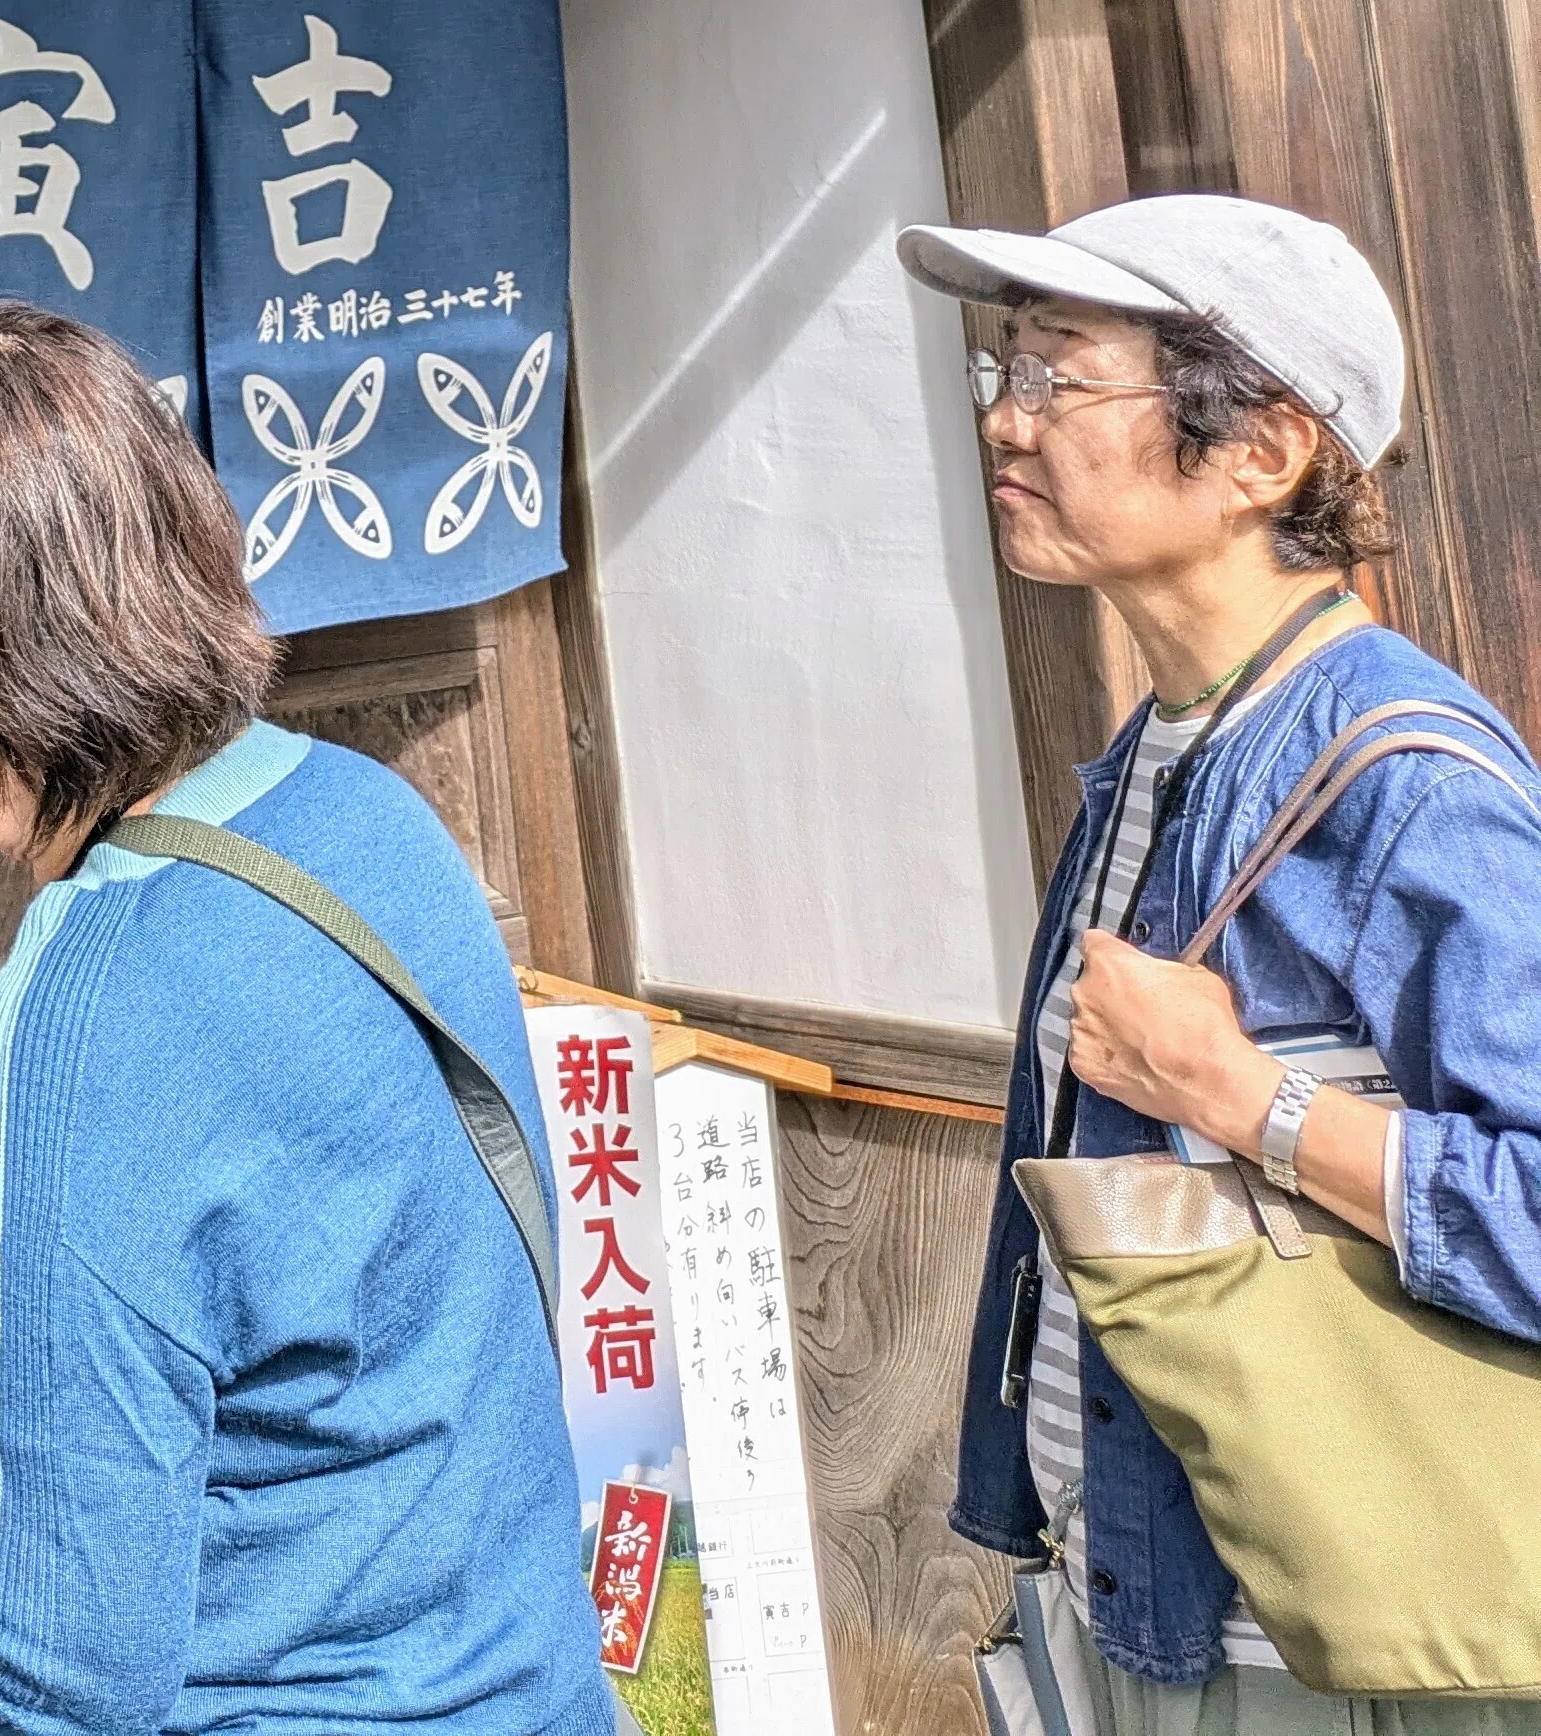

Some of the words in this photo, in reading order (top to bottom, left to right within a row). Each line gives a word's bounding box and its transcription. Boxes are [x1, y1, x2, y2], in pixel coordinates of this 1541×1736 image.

[256, 270, 524, 347] 創業明治三十七年
[555, 1033, 658, 1395] 新米入荷
[601, 1510, 652, 1648] 新潟米
[708, 1583, 735, 1601] 当店
